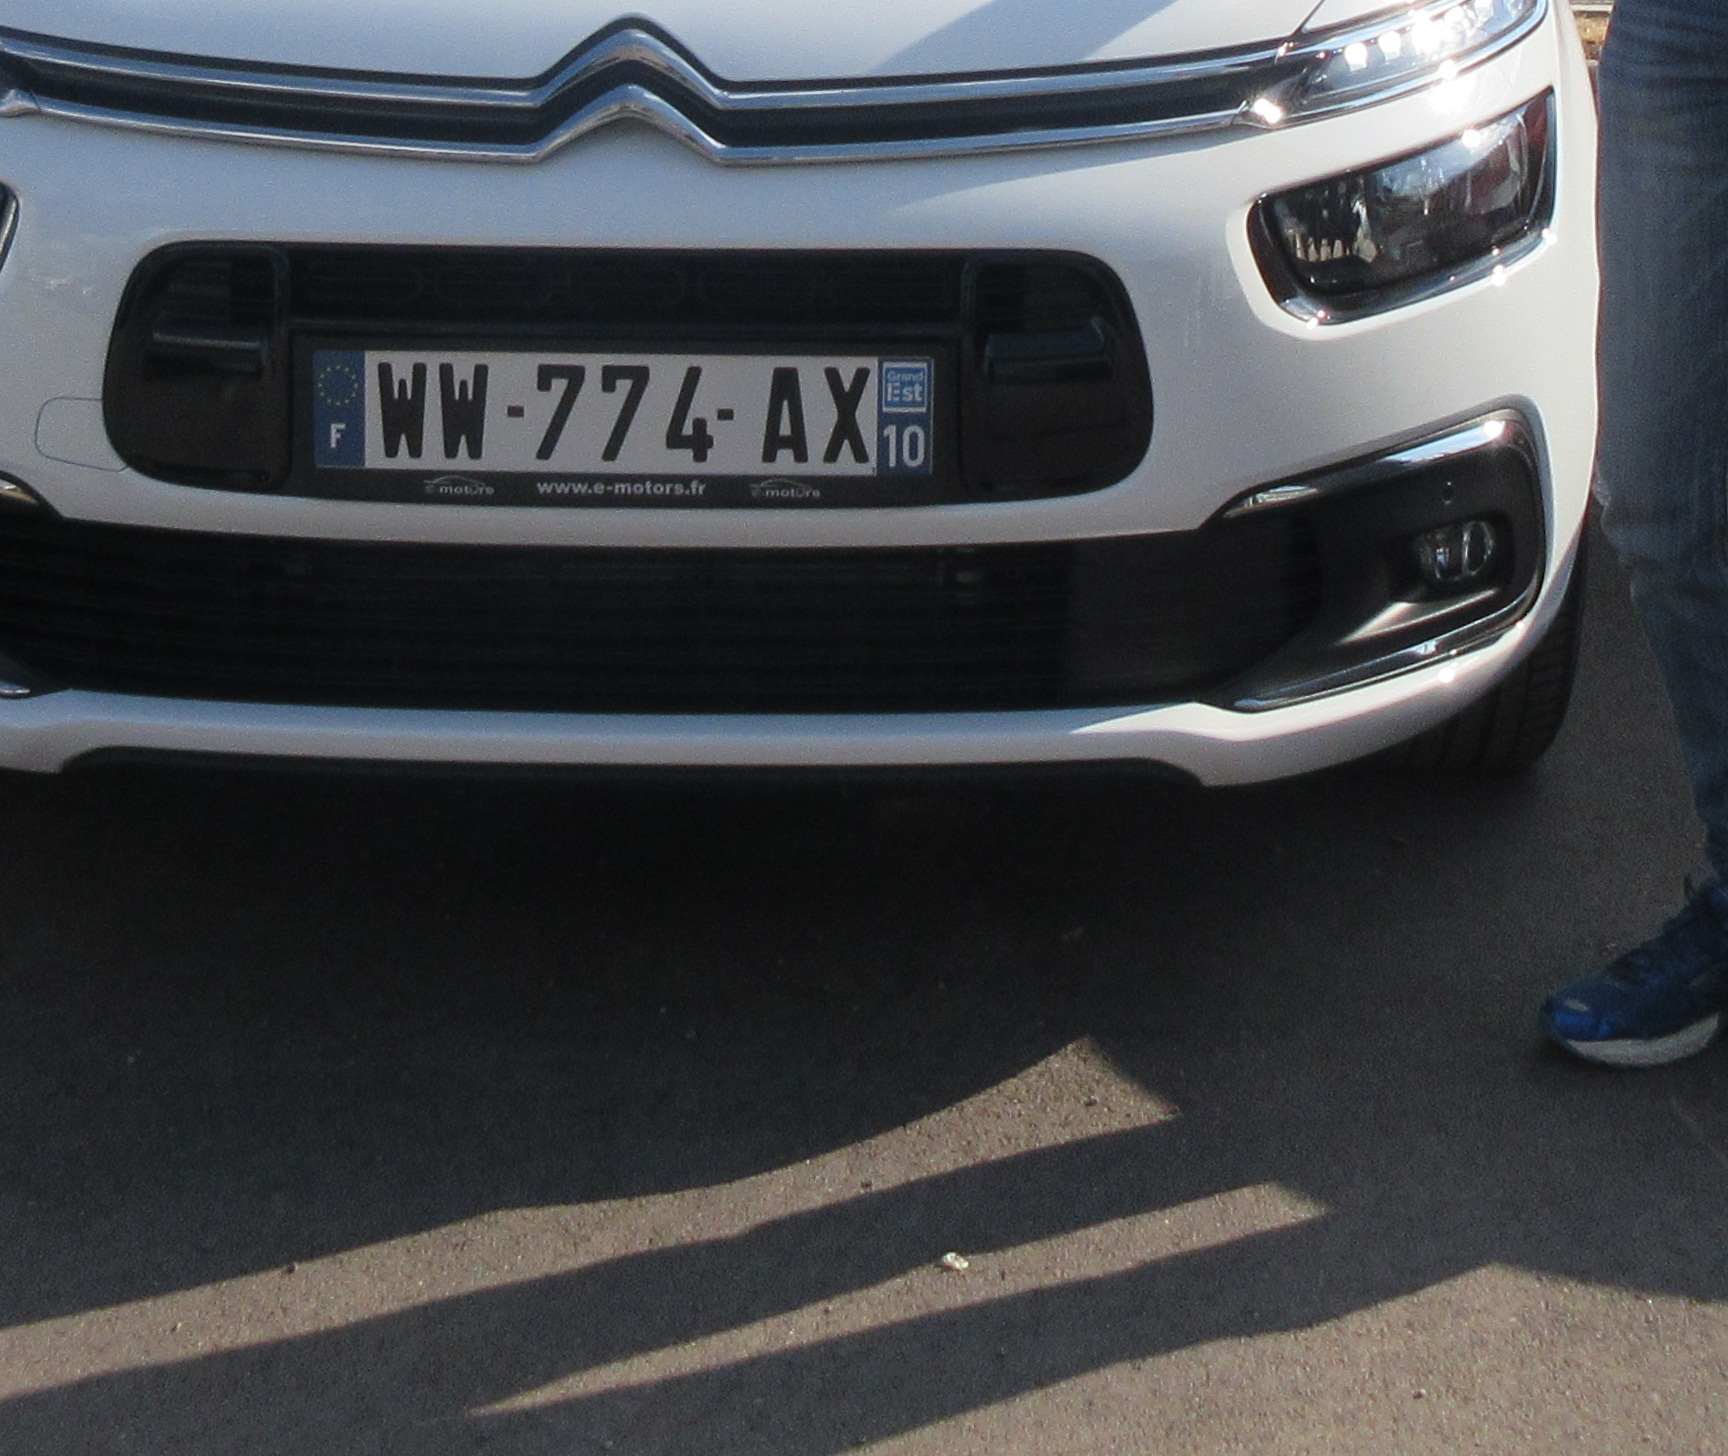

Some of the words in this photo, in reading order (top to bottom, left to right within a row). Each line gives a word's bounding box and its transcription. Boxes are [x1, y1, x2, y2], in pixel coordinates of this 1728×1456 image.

[887, 371, 923, 382] Grand
[887, 382, 923, 402] Est
[330, 423, 347, 448] F
[883, 424, 925, 467] 10
[537, 480, 707, 495] www.e-motors.fr
